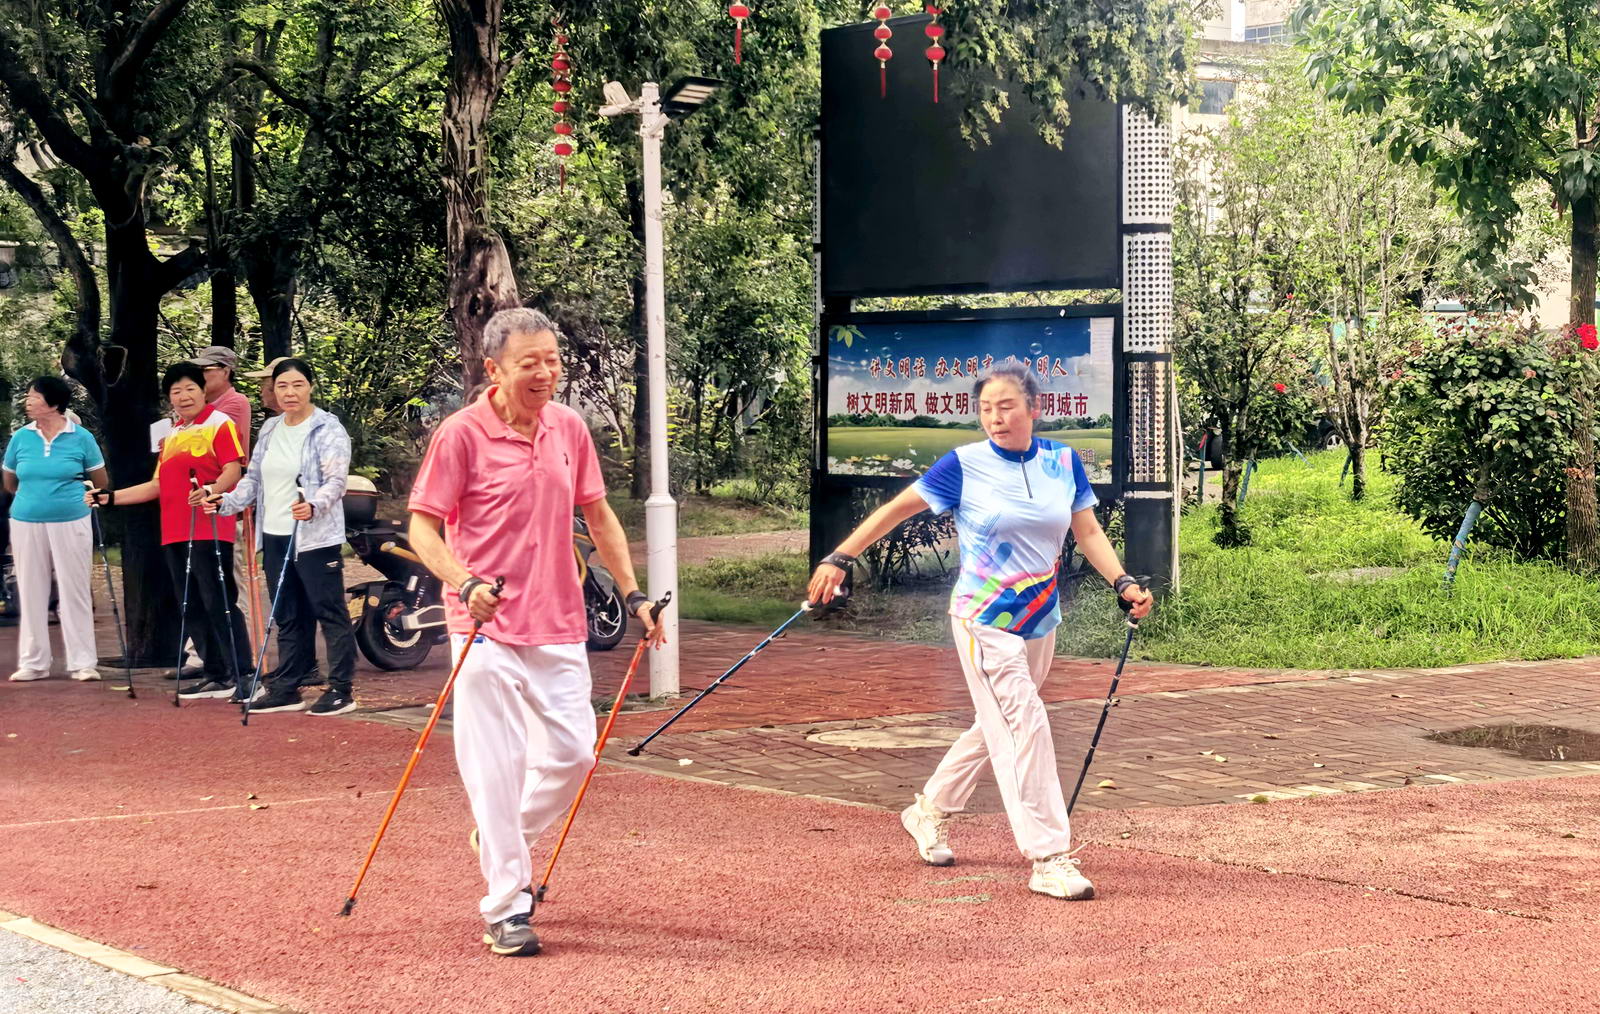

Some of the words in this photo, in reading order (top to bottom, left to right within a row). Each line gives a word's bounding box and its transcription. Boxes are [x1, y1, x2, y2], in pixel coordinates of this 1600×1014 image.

[846, 391, 917, 414] 树文明新风
